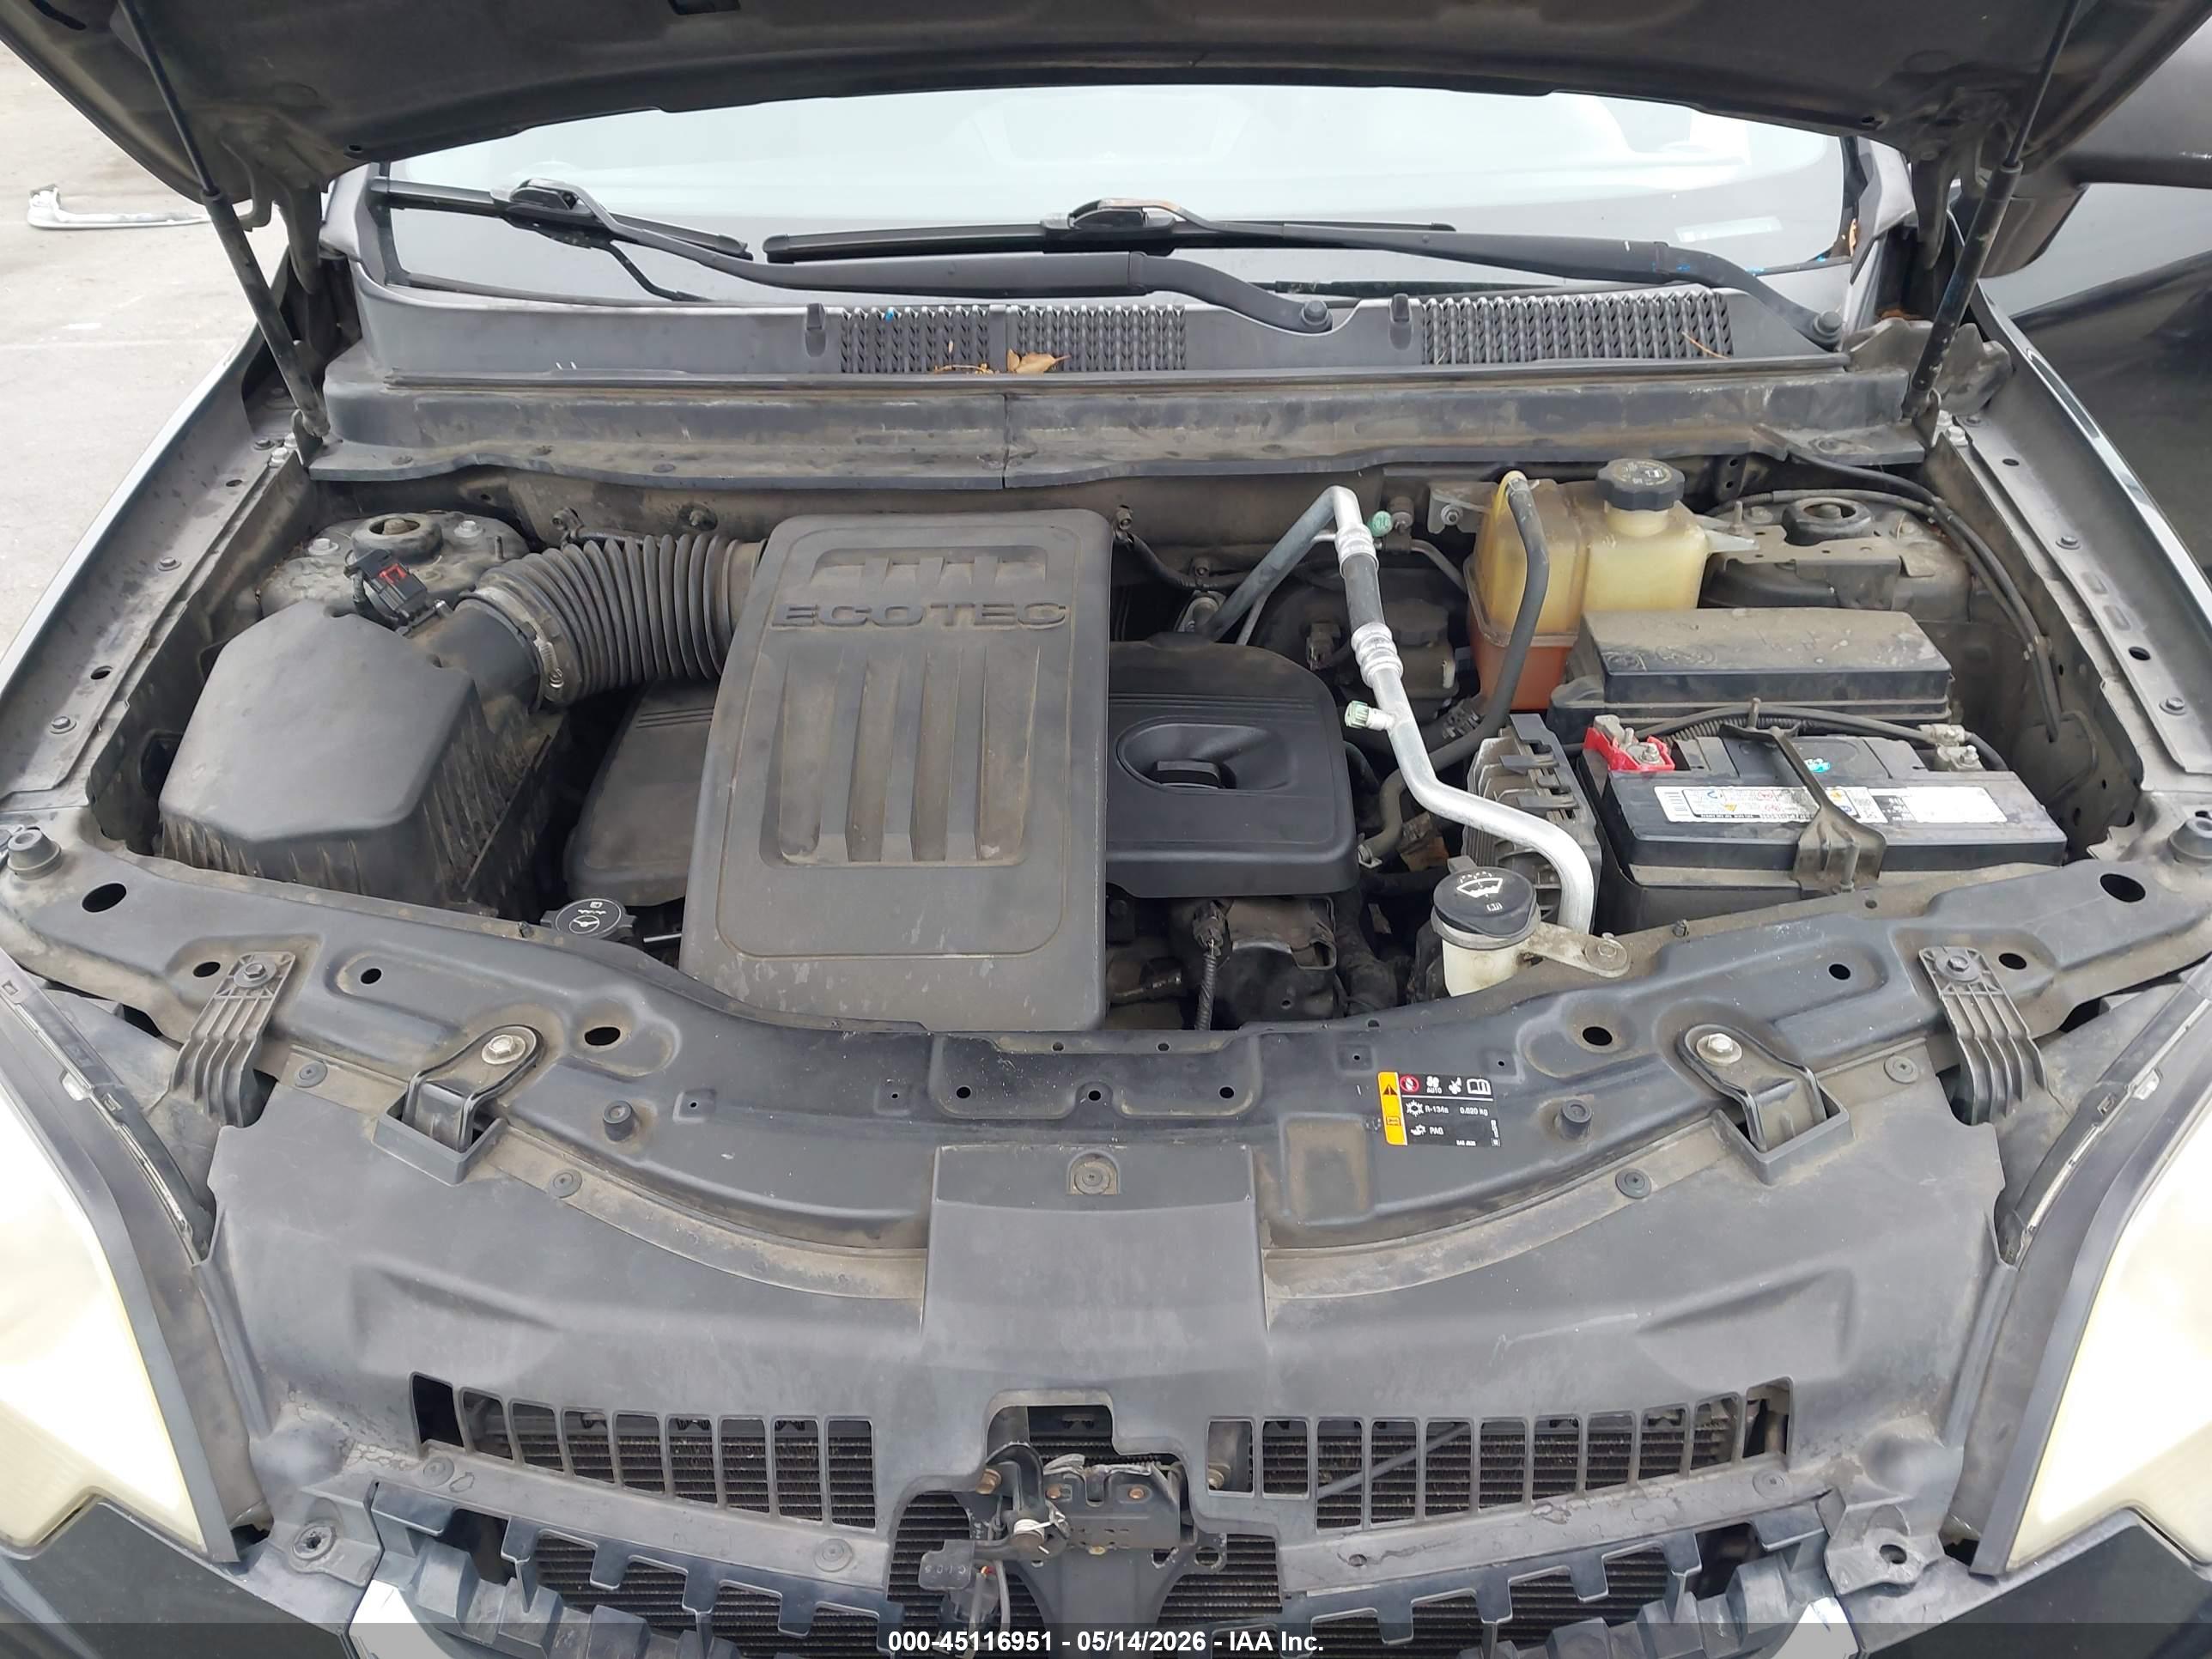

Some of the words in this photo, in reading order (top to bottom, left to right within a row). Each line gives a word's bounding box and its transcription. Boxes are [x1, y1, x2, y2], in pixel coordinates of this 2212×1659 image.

[770, 601, 1067, 628] ECOTEC
[1426, 1086, 1443, 1095] AUTO
[1425, 1105, 1449, 1114] R-134a
